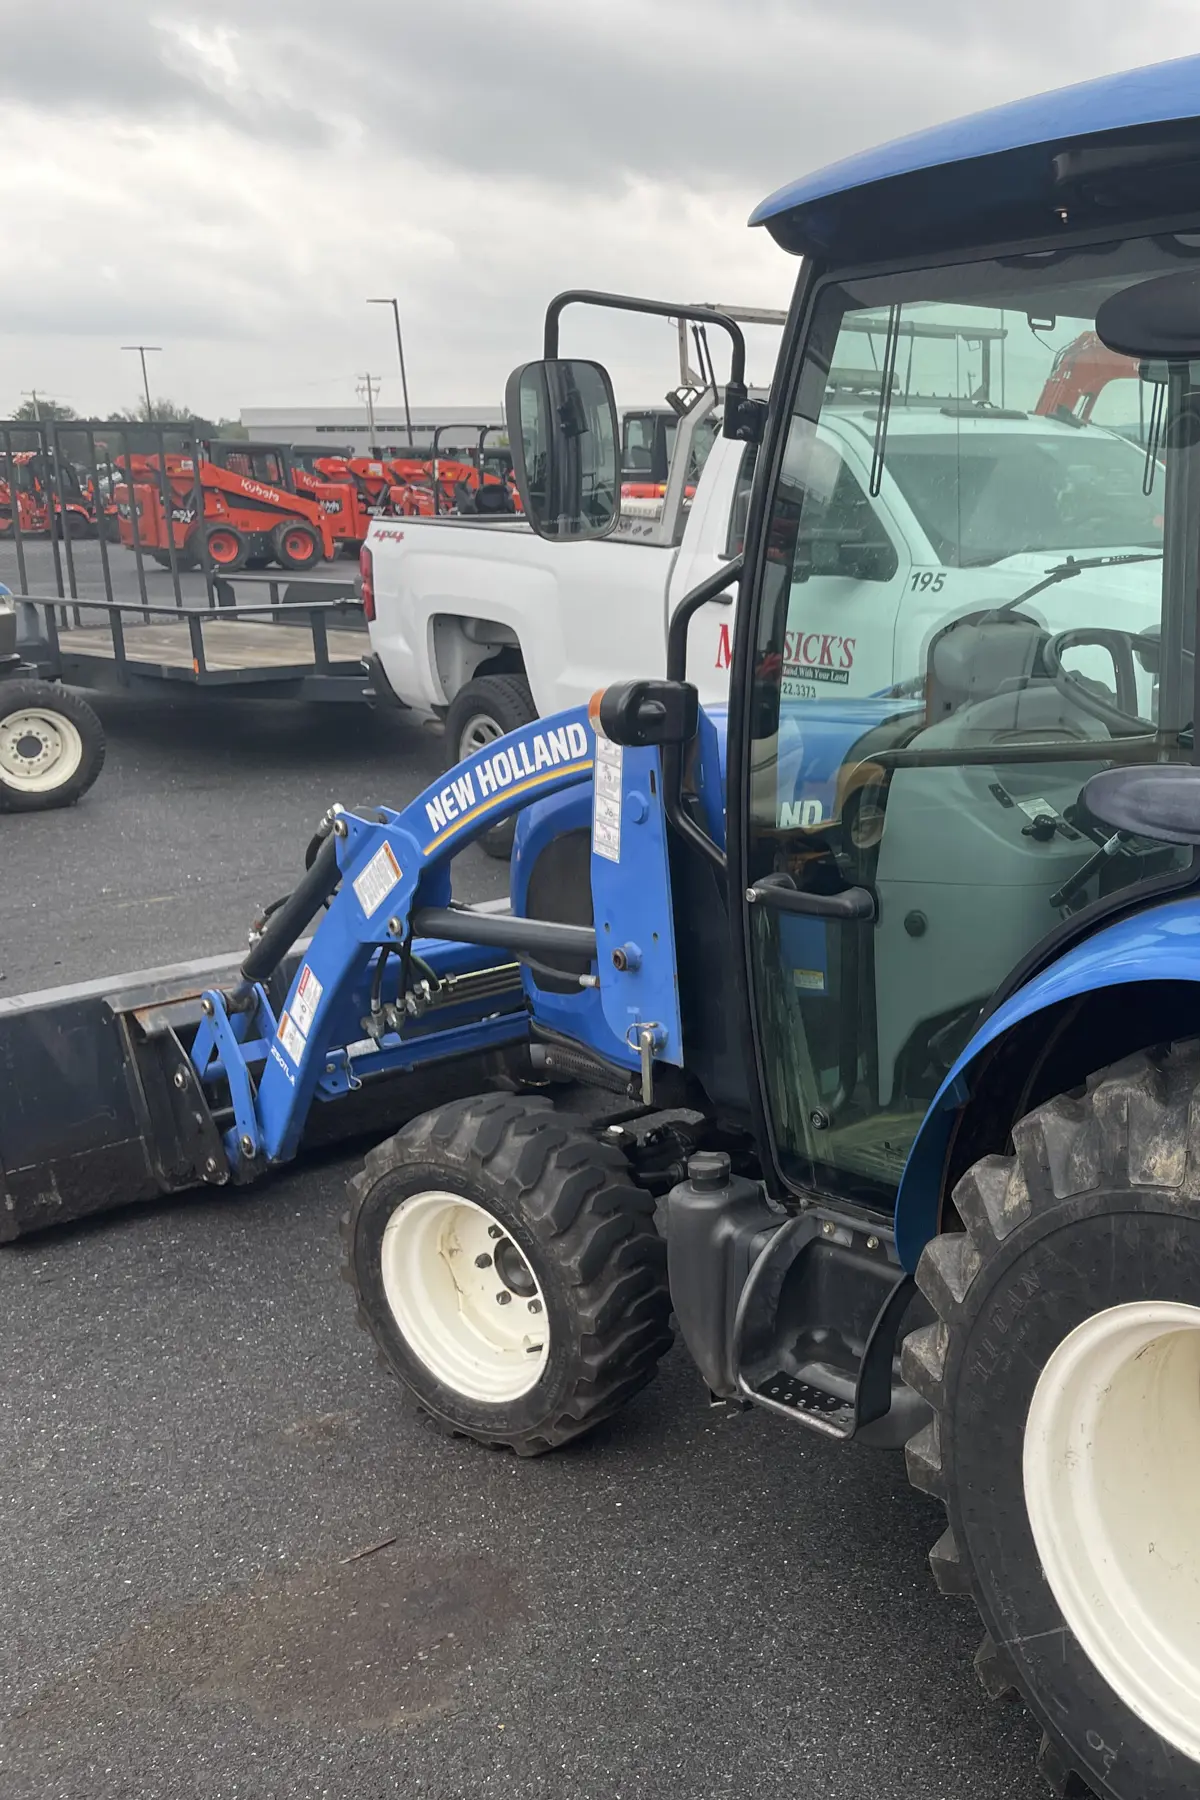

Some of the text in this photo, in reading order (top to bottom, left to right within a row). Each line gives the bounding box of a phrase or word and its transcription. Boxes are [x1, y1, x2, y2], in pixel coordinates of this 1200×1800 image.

[240, 479, 280, 502] Kubota
[911, 572, 947, 592] 195
[715, 623, 856, 669] MSICK'S
[425, 722, 588, 833] NEW HOLLAND
